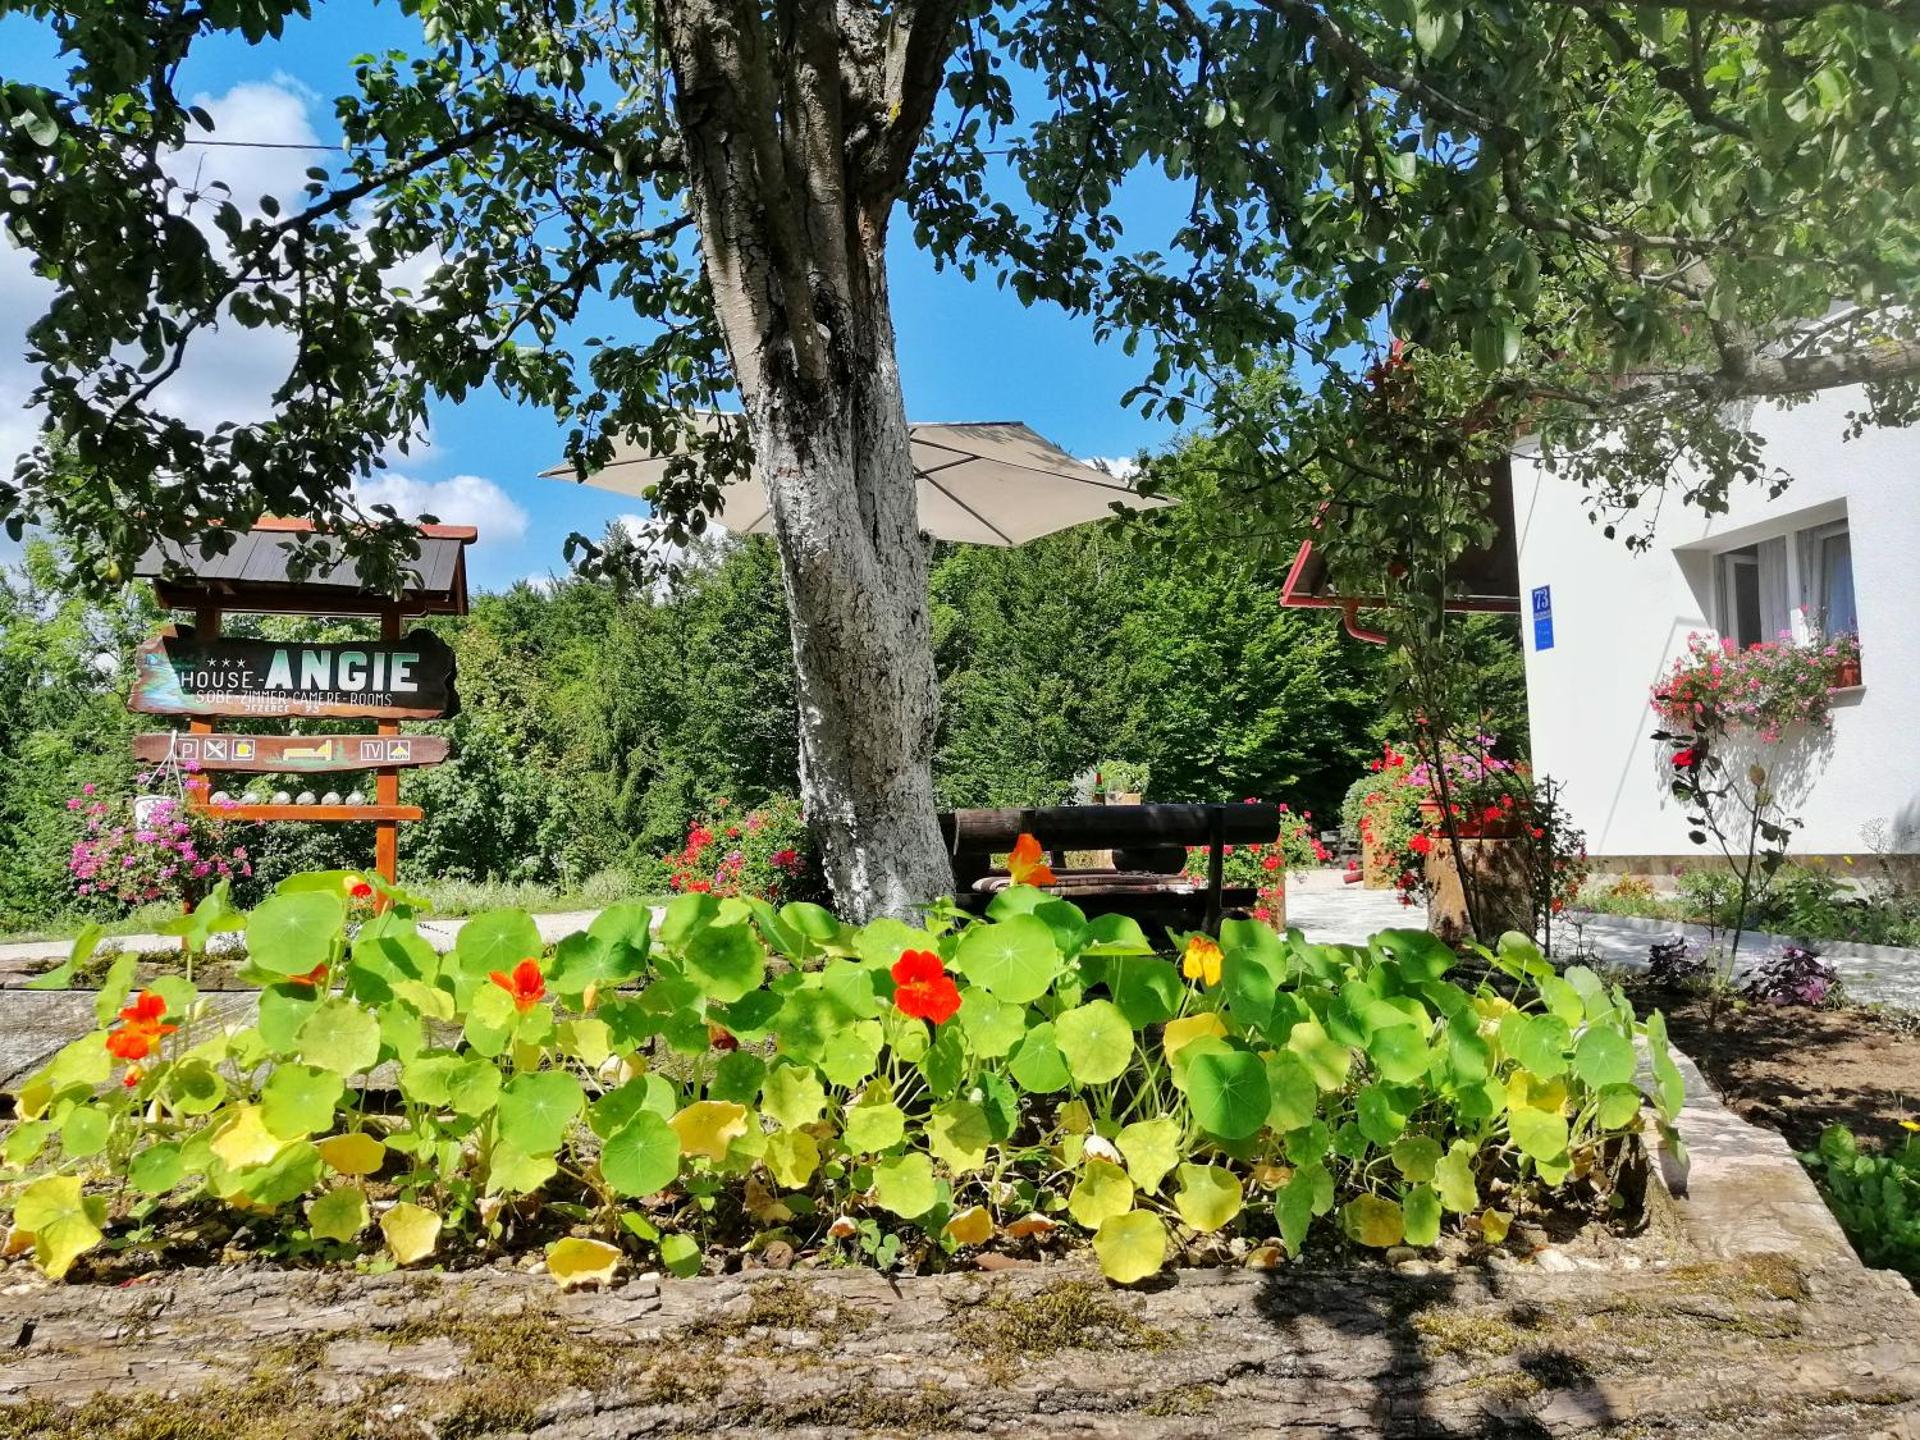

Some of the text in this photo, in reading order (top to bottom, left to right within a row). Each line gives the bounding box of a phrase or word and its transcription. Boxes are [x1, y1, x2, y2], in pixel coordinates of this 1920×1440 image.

[1534, 588, 1549, 610] 73
[264, 649, 420, 692] ANGIE
[182, 743, 193, 758] P
[364, 743, 381, 758] TV
